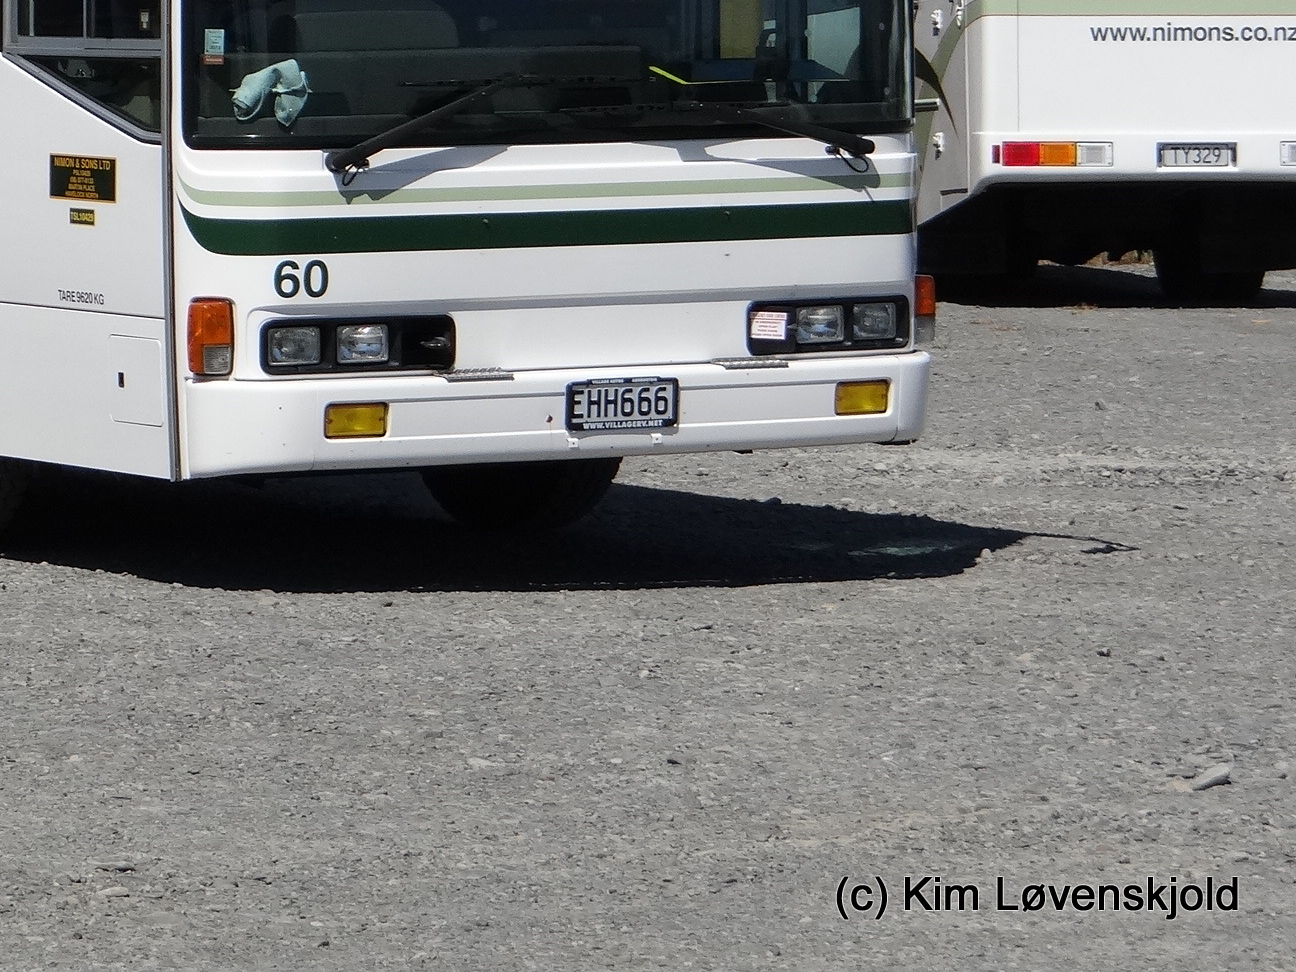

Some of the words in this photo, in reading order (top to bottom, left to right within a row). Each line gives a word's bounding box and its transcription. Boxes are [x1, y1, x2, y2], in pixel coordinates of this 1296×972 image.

[1090, 22, 1296, 42] www.nimons.co.nz
[54, 157, 75, 168] NIMON
[75, 159, 80, 168] &
[81, 159, 98, 170] SONS
[99, 160, 110, 170] LTD
[1170, 147, 1221, 164] TY329
[274, 259, 329, 299] 60
[57, 289, 76, 303] TARE
[76, 291, 93, 304] 9620
[94, 293, 104, 305] KG
[571, 387, 669, 419] EHH666
[583, 419, 663, 430] WWW.VILLAGERV.NET
